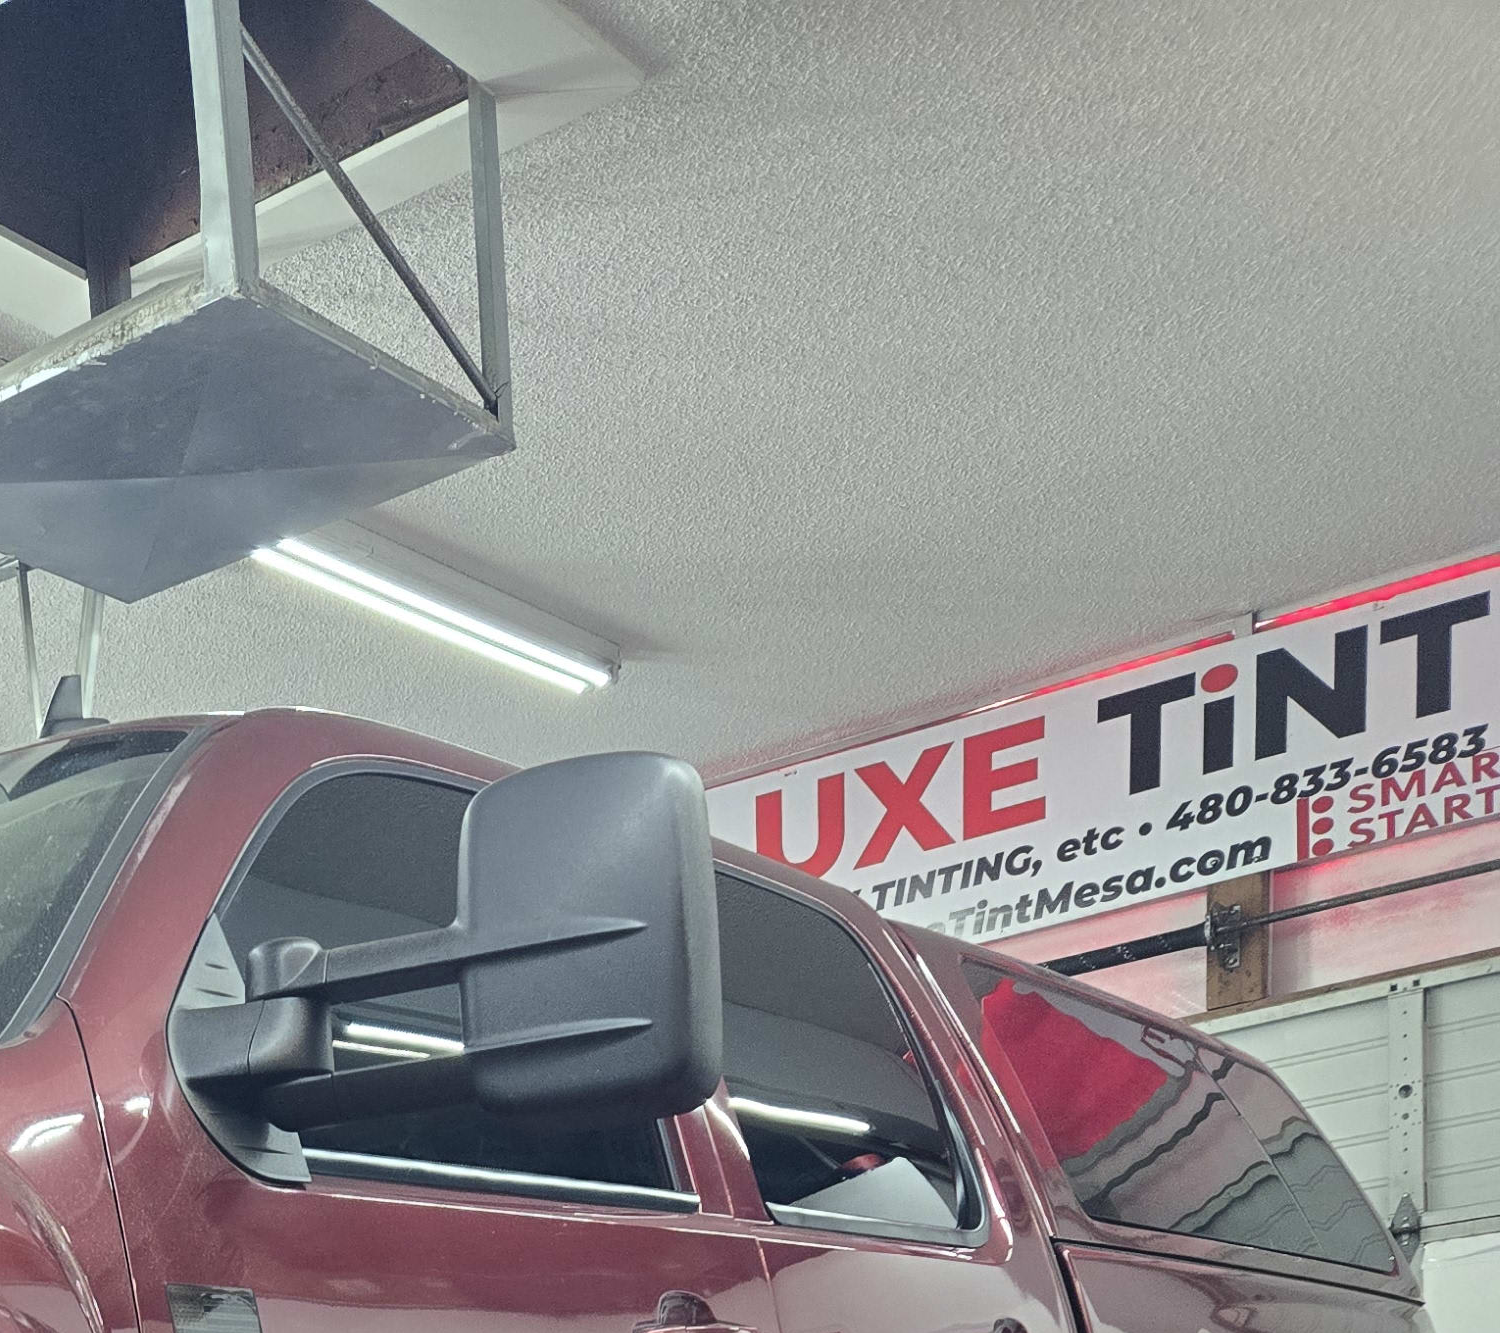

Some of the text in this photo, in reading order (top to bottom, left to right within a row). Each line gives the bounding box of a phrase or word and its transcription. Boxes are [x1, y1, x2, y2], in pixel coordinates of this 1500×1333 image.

[872, 724, 1489, 911] TINTING, etc 480-833-6583
[1347, 784, 1500, 847] START
